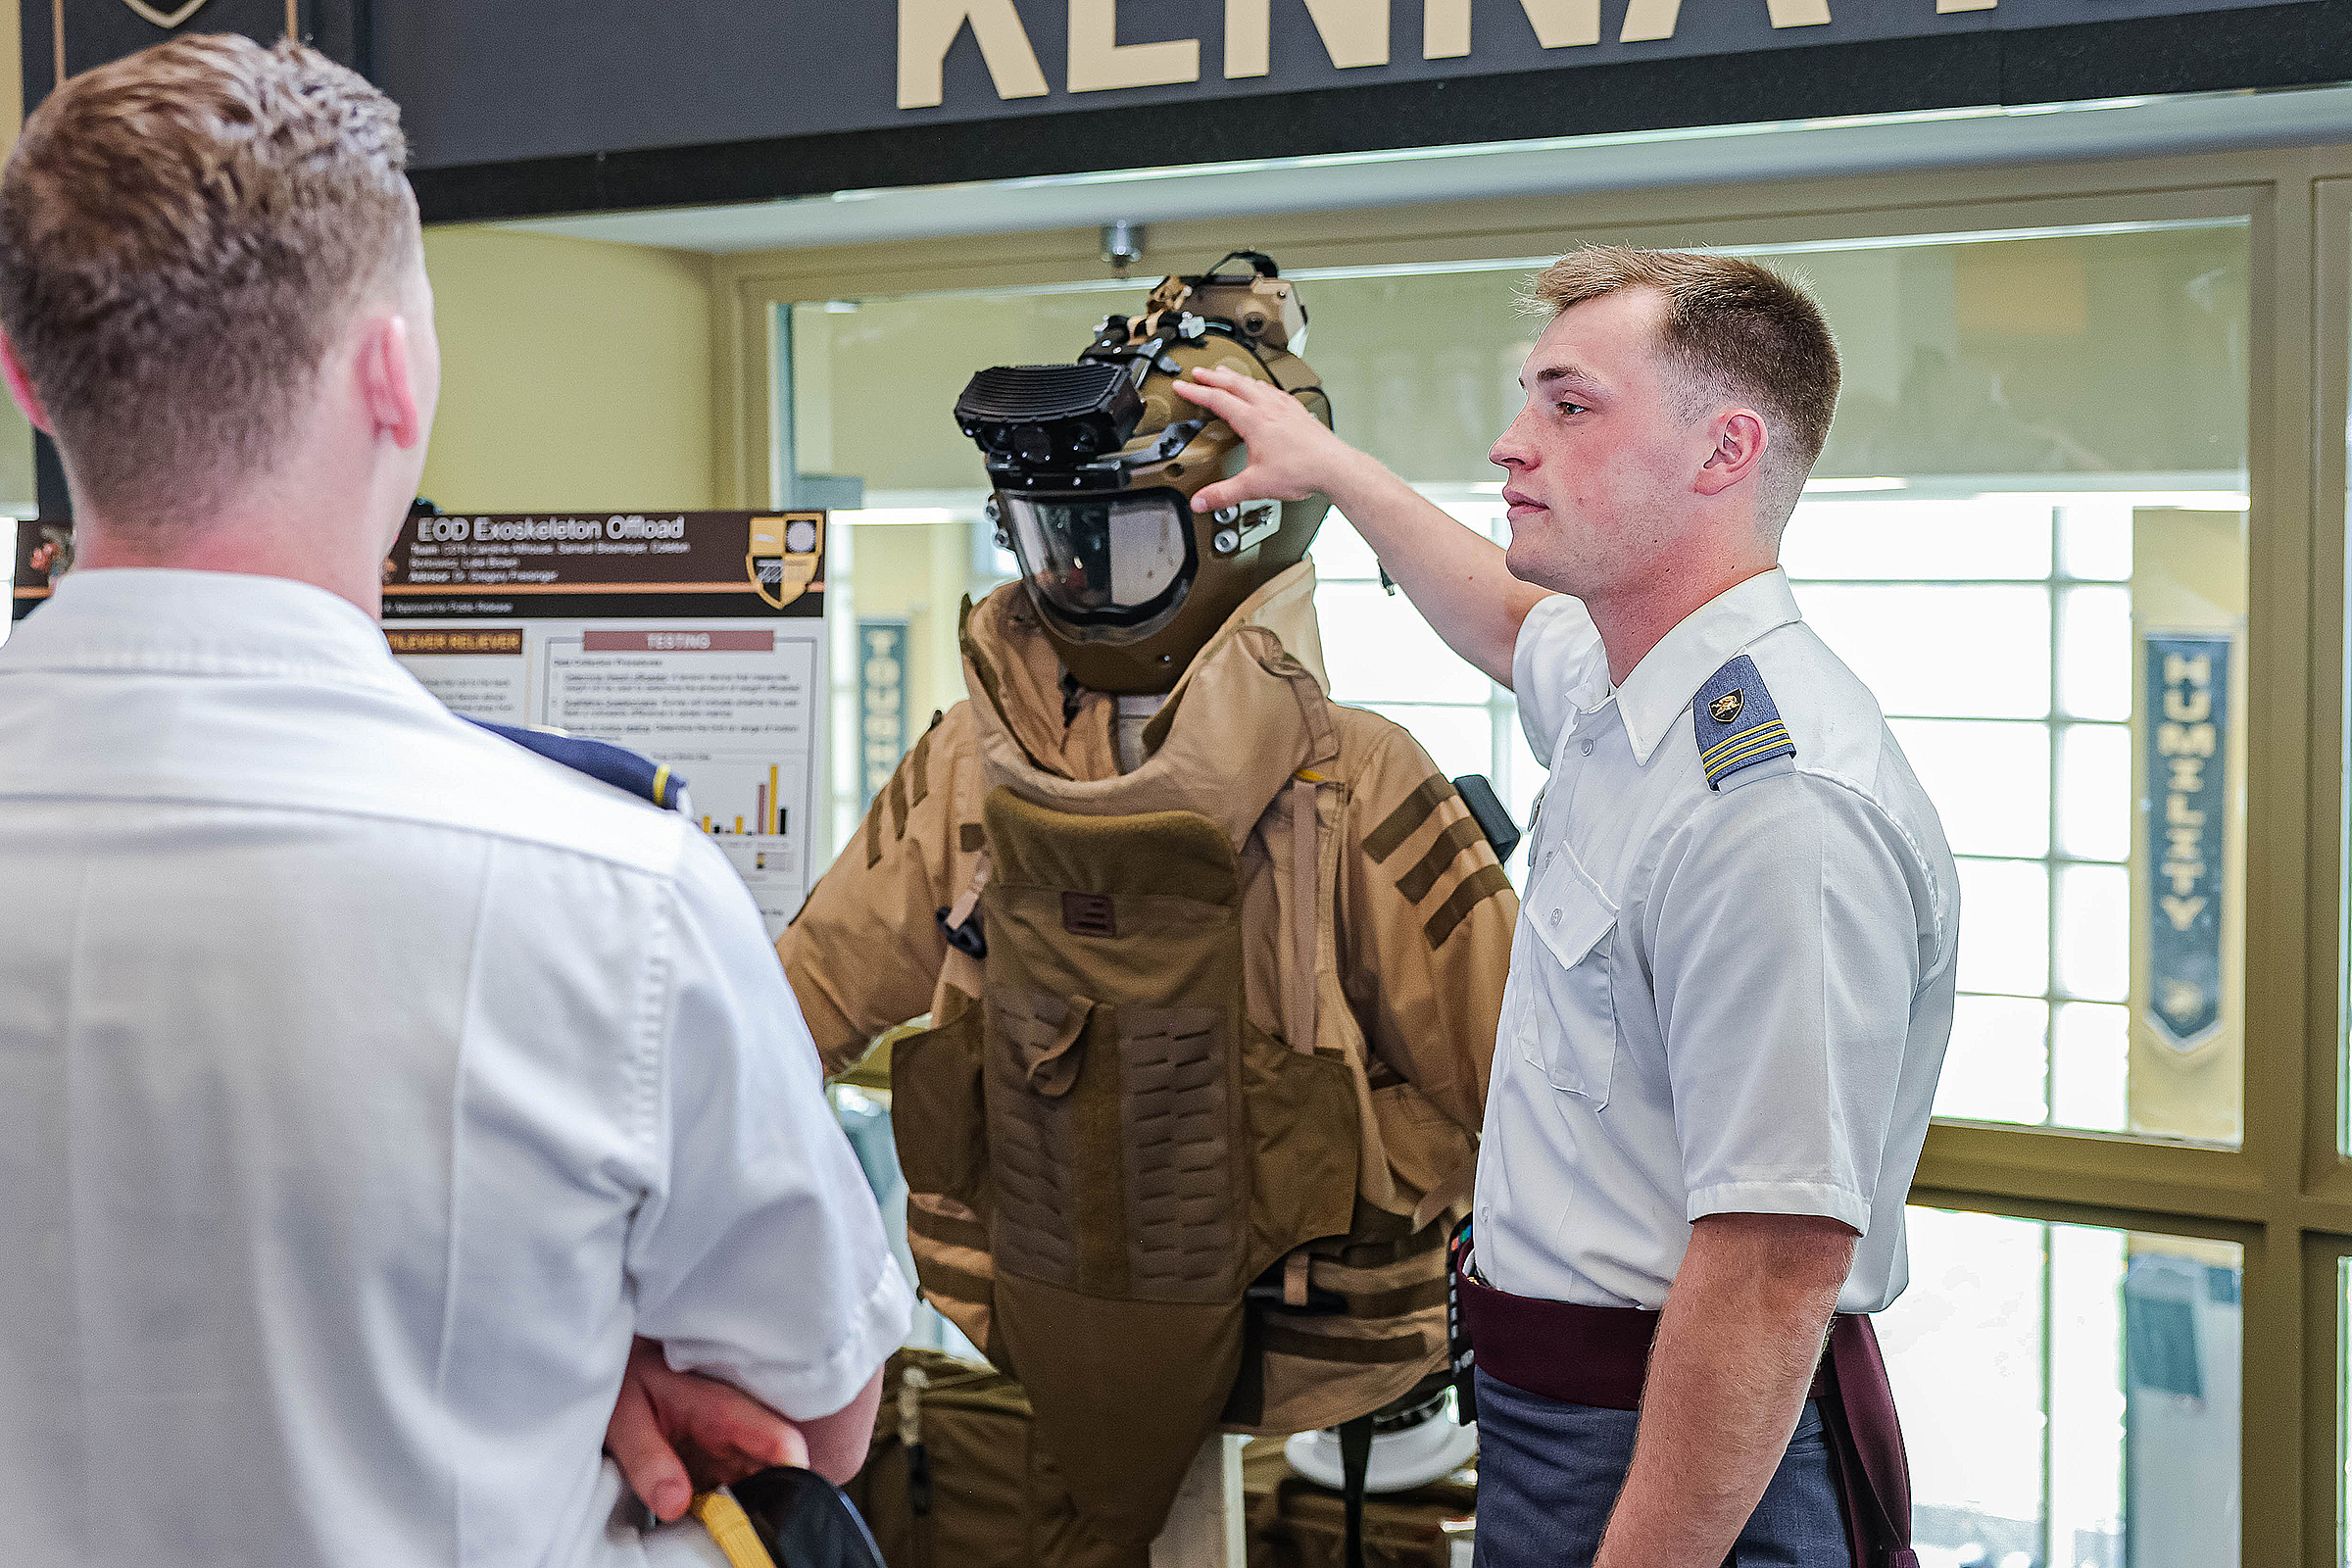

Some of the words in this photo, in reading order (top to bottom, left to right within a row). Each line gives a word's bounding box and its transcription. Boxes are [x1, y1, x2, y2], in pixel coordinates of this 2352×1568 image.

[417, 517, 470, 542] EOD
[473, 516, 602, 541] Exoskeleton
[606, 514, 685, 540] Offload
[648, 632, 711, 649] TESTING
[2157, 652, 2217, 931] HUMILITY
